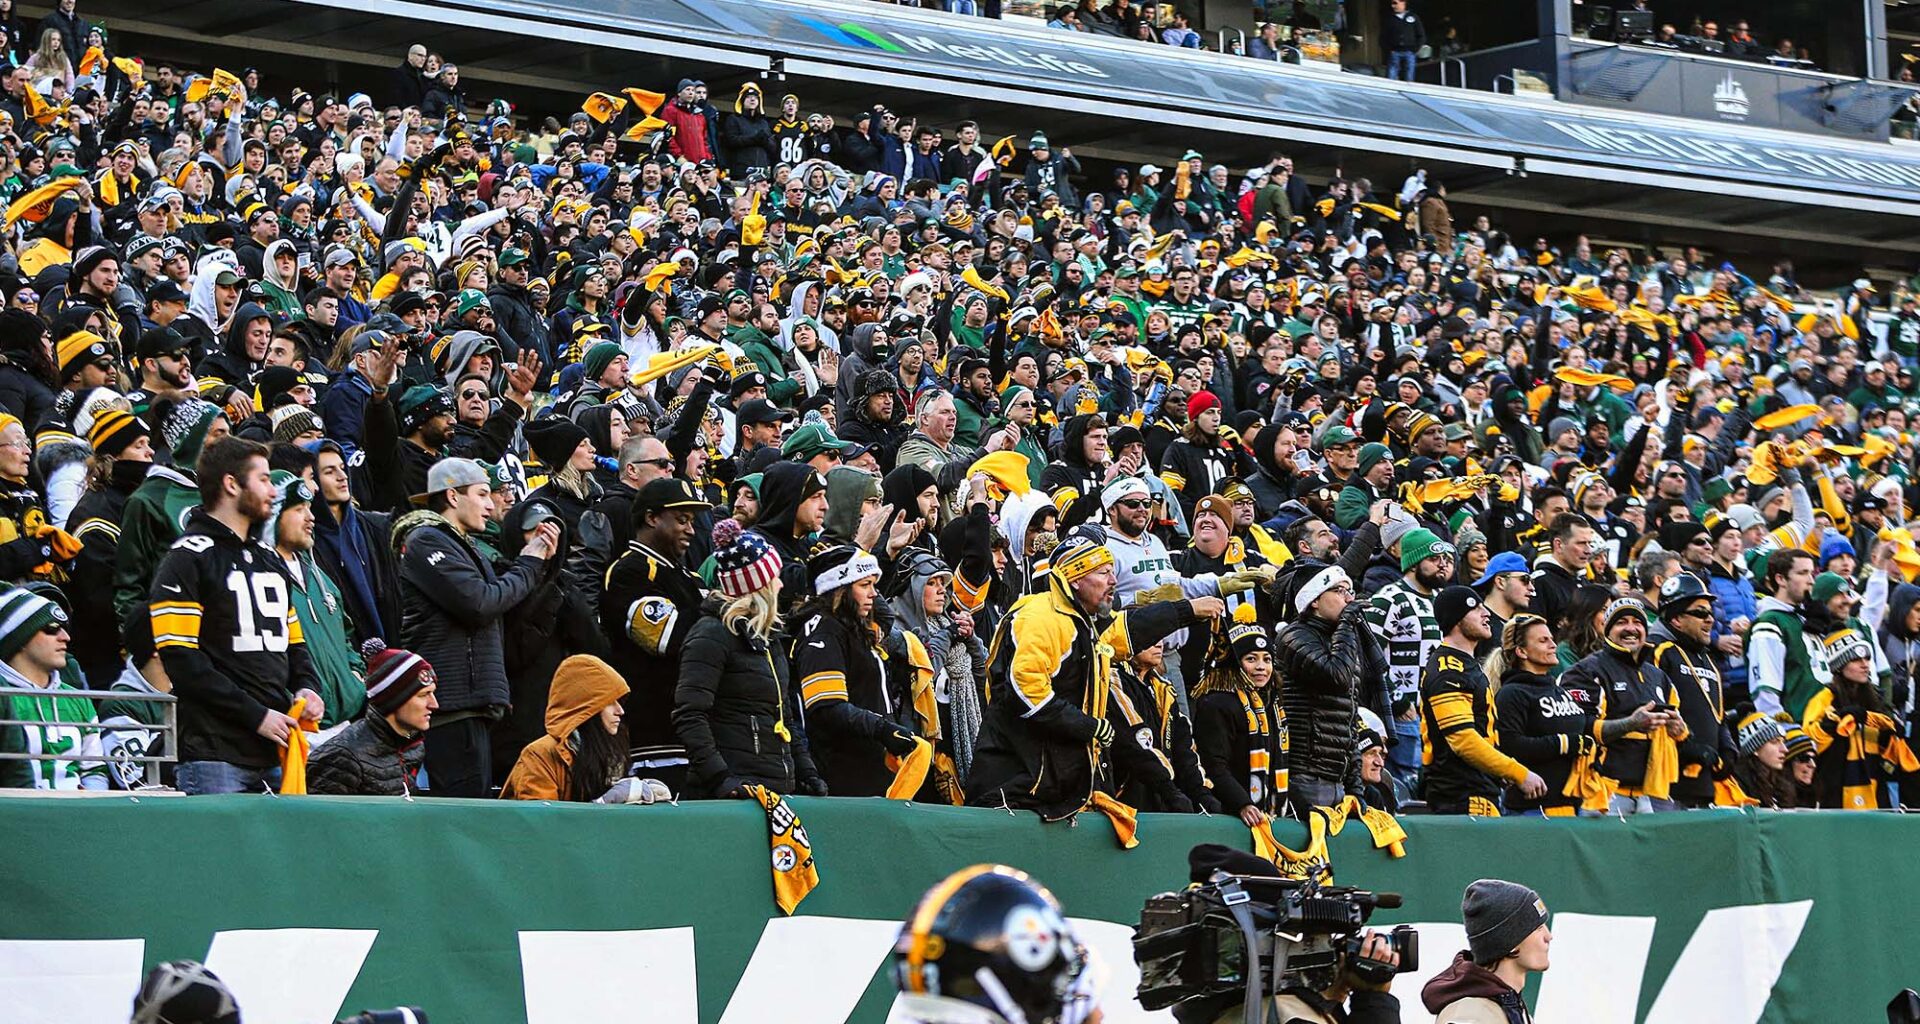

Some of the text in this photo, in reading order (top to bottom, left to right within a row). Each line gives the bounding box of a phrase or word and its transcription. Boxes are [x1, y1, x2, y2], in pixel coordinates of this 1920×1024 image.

[887, 31, 1110, 78] MetLife
[781, 137, 803, 163] 86
[1132, 559, 1174, 574] JETS
[227, 570, 289, 653] 19
[804, 614, 822, 637] 19
[1437, 656, 1464, 673] 19
